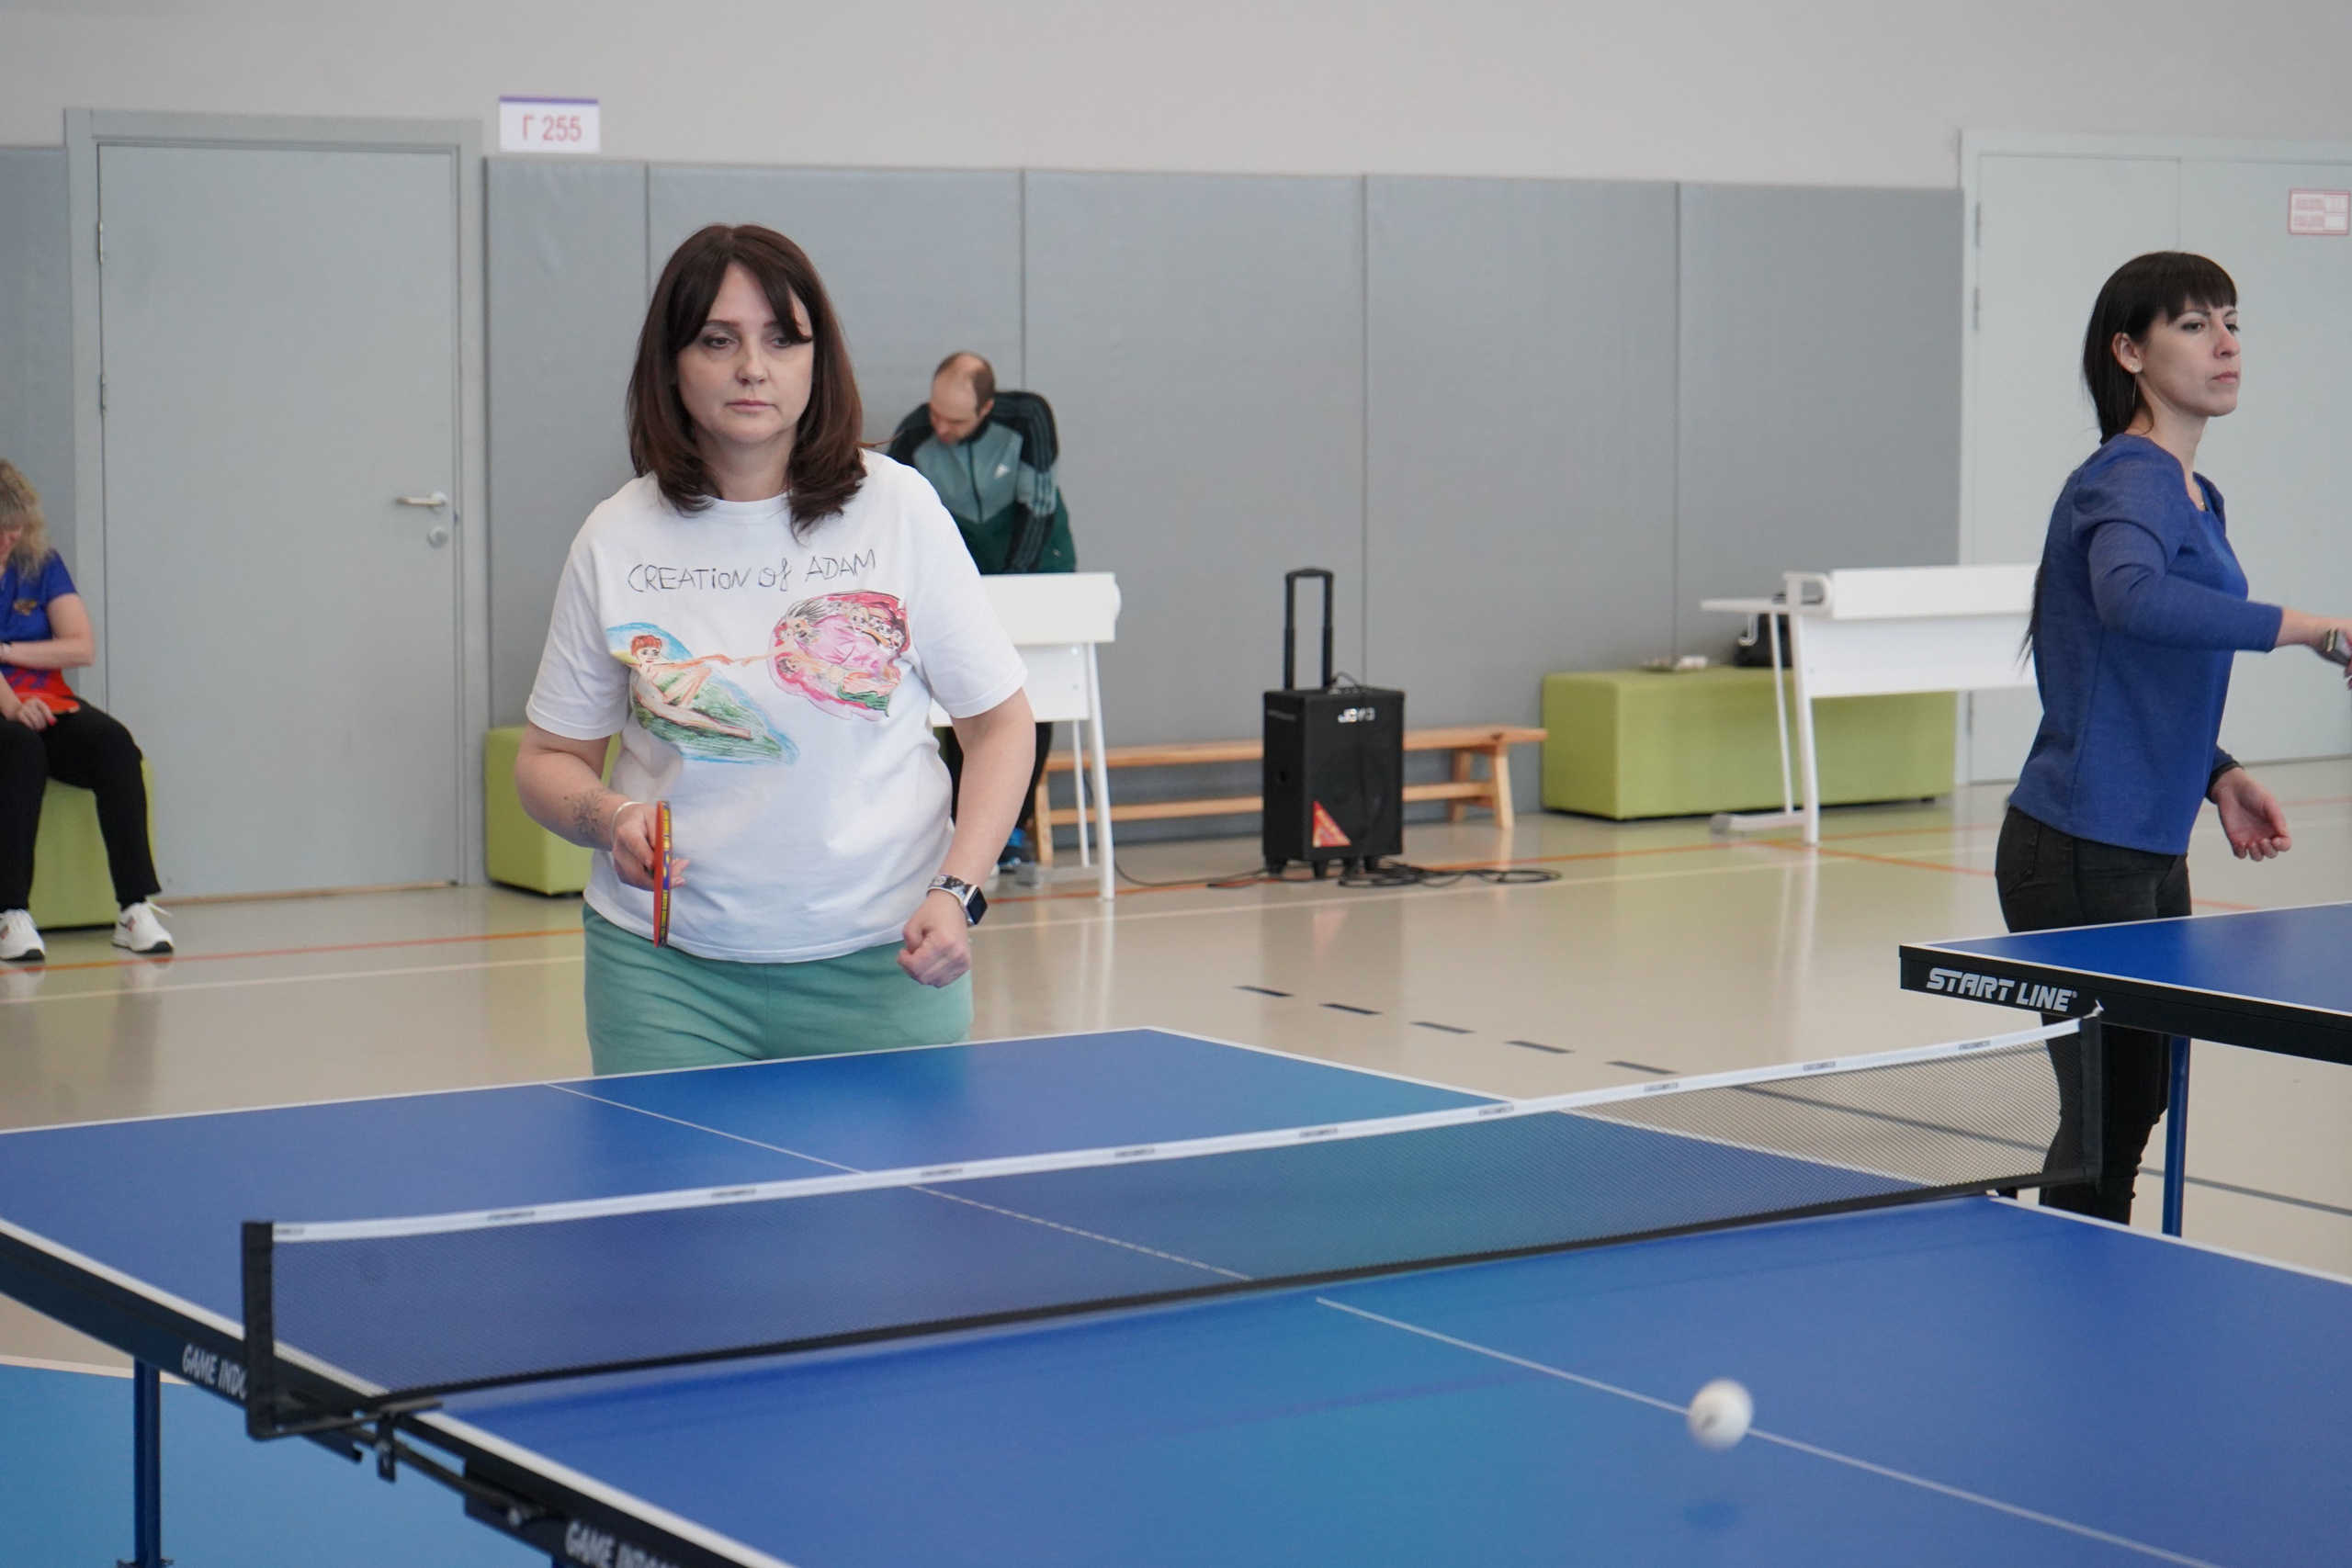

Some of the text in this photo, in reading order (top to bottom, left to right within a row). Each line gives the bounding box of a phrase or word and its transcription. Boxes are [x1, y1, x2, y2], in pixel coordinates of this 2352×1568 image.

[541, 115, 582, 141] 255
[805, 548, 876, 583] ADAM
[1926, 967, 2016, 1001] START
[182, 1342, 218, 1386] GAME
